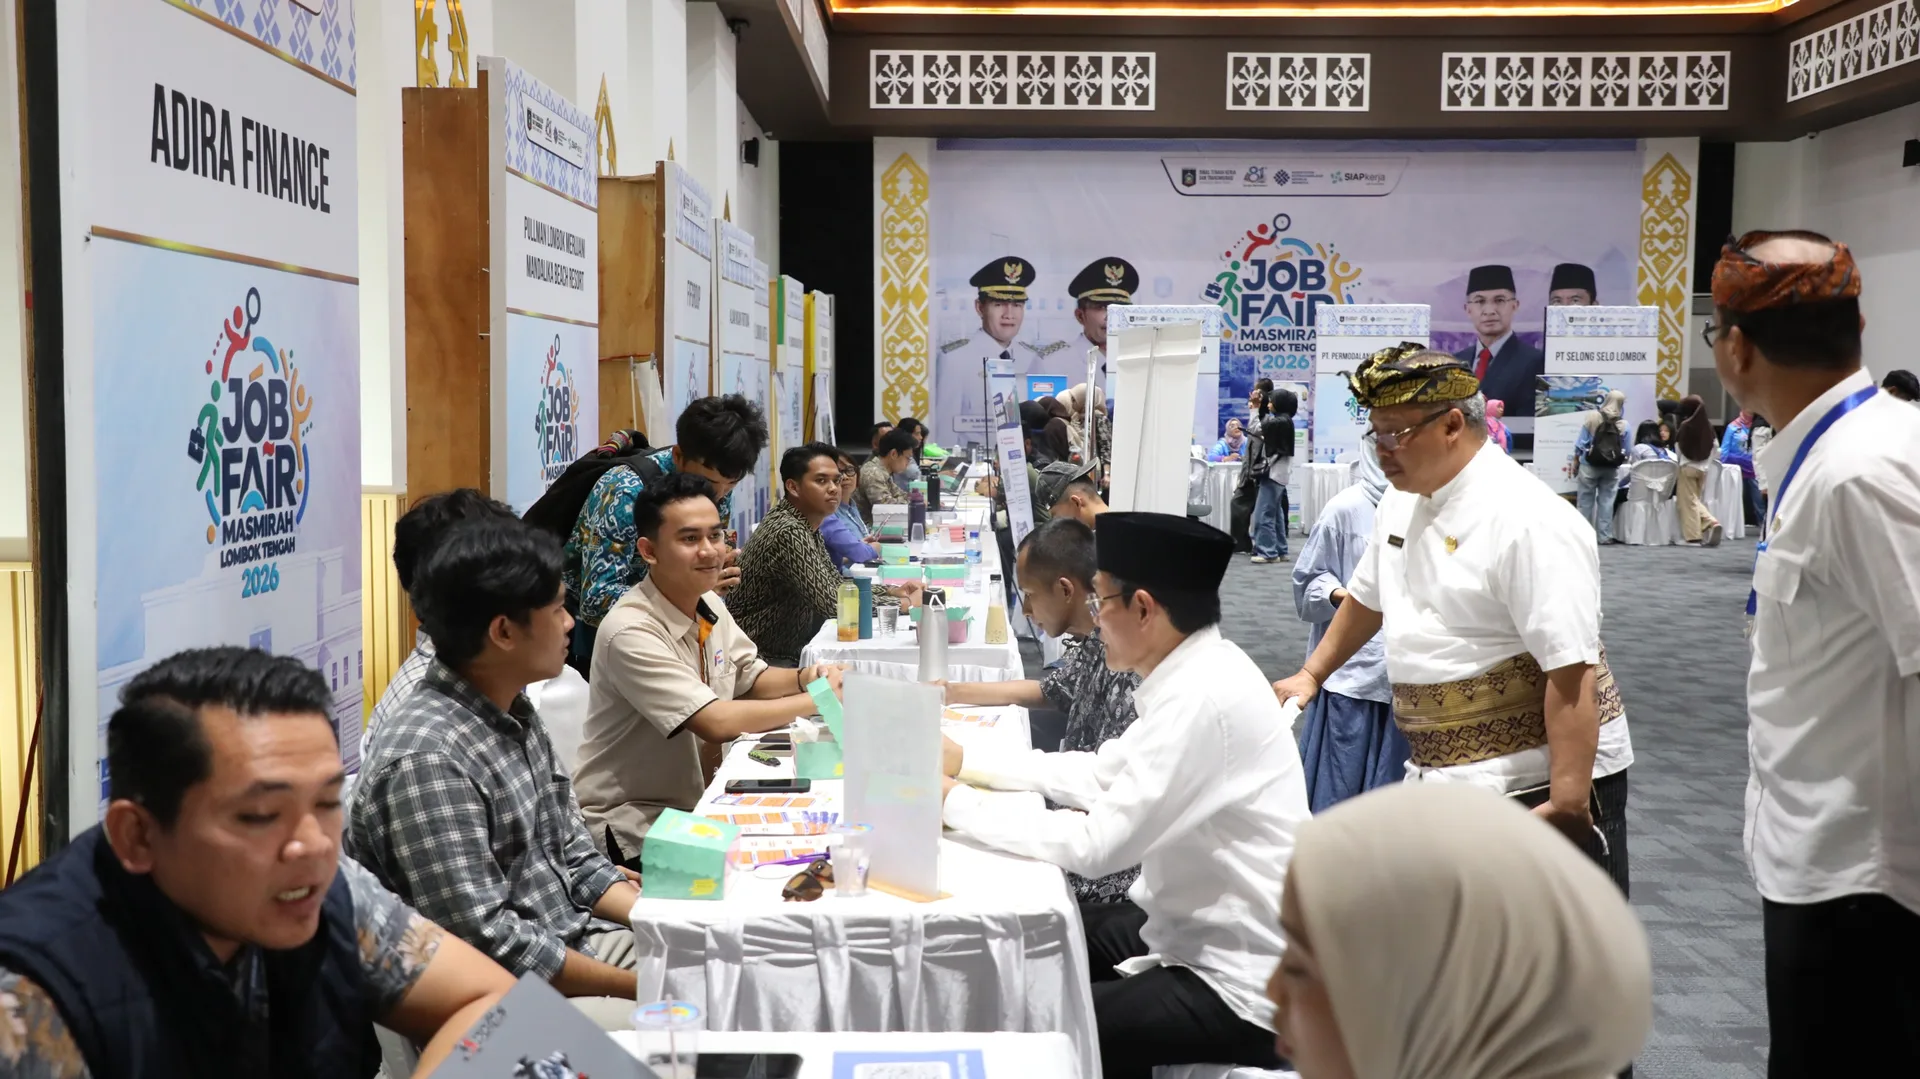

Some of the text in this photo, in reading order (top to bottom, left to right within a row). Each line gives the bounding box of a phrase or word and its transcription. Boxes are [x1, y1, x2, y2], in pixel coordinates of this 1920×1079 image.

[151, 82, 330, 214] ADIRA FINANCE
[1344, 173, 1385, 183] SIAPkerja
[524, 215, 547, 246] PULLMAN
[548, 224, 566, 253] LOMBOK
[526, 254, 585, 292] MANDALIKA BEACH RESORT
[1242, 259, 1326, 292] JOB
[1238, 343, 1316, 352] LOMBOK TENG
[1240, 329, 1316, 341] MASMIRA
[1262, 354, 1310, 370] 2026
[1555, 352, 1647, 361] PT SELONG SELO LOMBOK
[222, 378, 289, 443] JOB
[546, 386, 570, 423] JOB
[546, 424, 573, 464] FAIR
[222, 444, 297, 516] FAIR
[222, 510, 294, 546] MASMIRAH
[220, 537, 296, 569] LOMBOK TENGAH
[241, 562, 280, 599] 2026
